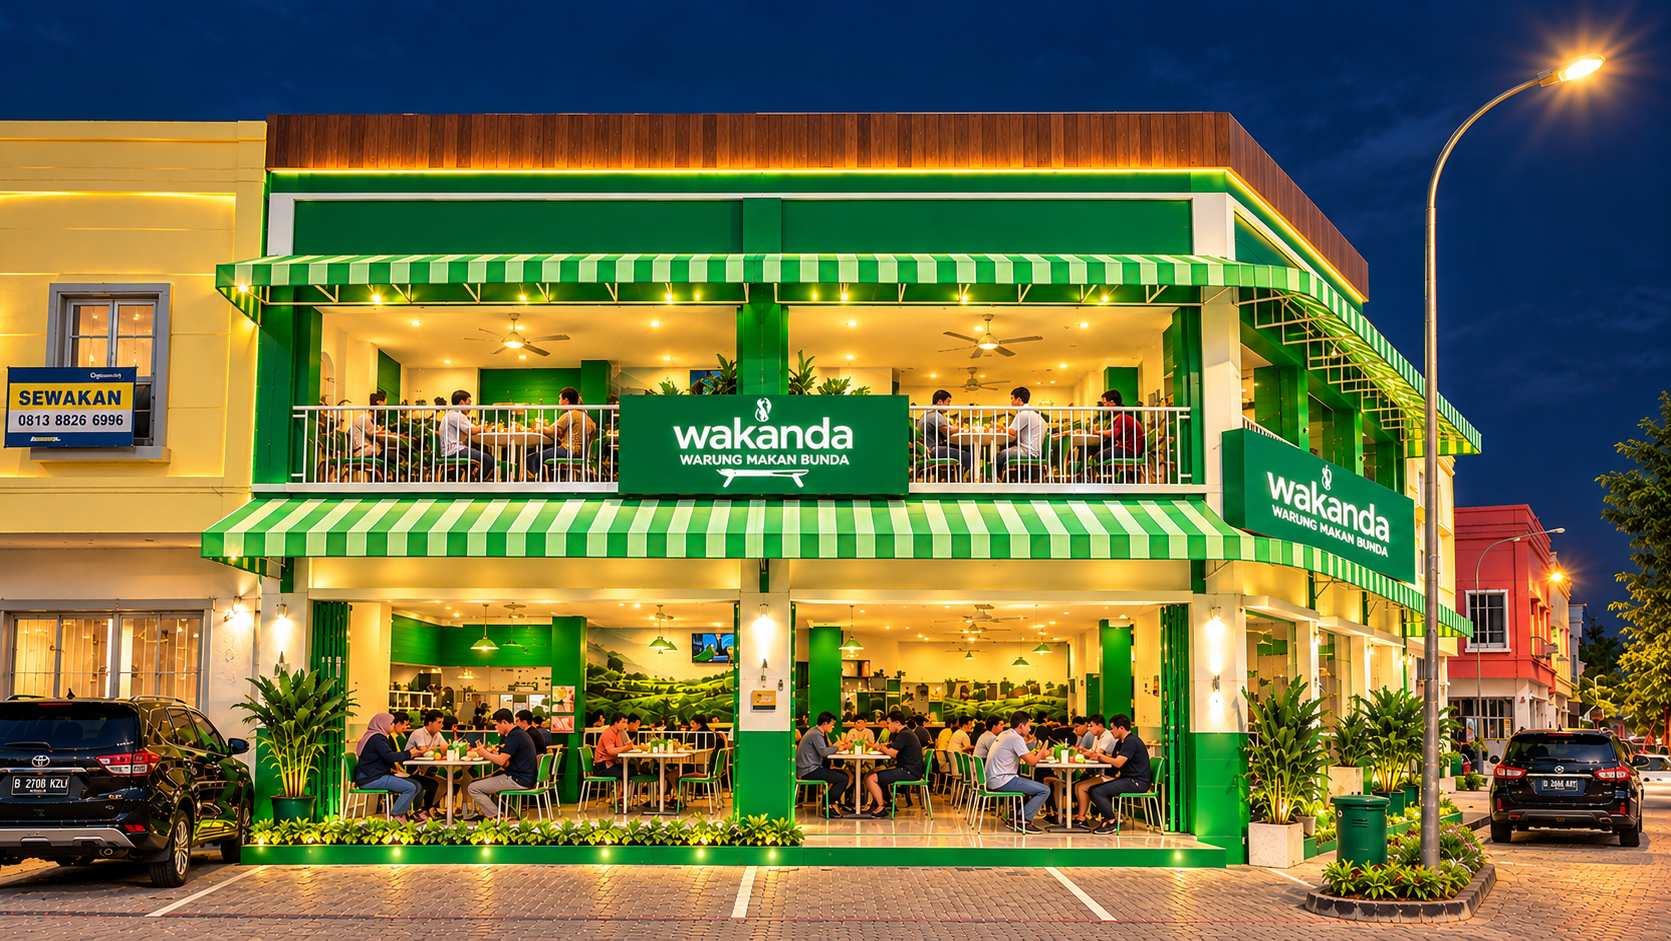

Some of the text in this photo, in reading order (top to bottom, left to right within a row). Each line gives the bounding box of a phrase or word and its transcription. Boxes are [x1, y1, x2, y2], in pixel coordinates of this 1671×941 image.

[19, 390, 121, 405] SEWAKAN
[18, 414, 124, 426] 0813 8826 6996
[673, 417, 853, 449] wakanda
[680, 454, 850, 465] WARUNG MAKAN BUNDA
[1266, 471, 1390, 543] wakanda
[1271, 504, 1389, 558] WARUNG MAKAN BUNDA
[14, 778, 21, 789] B
